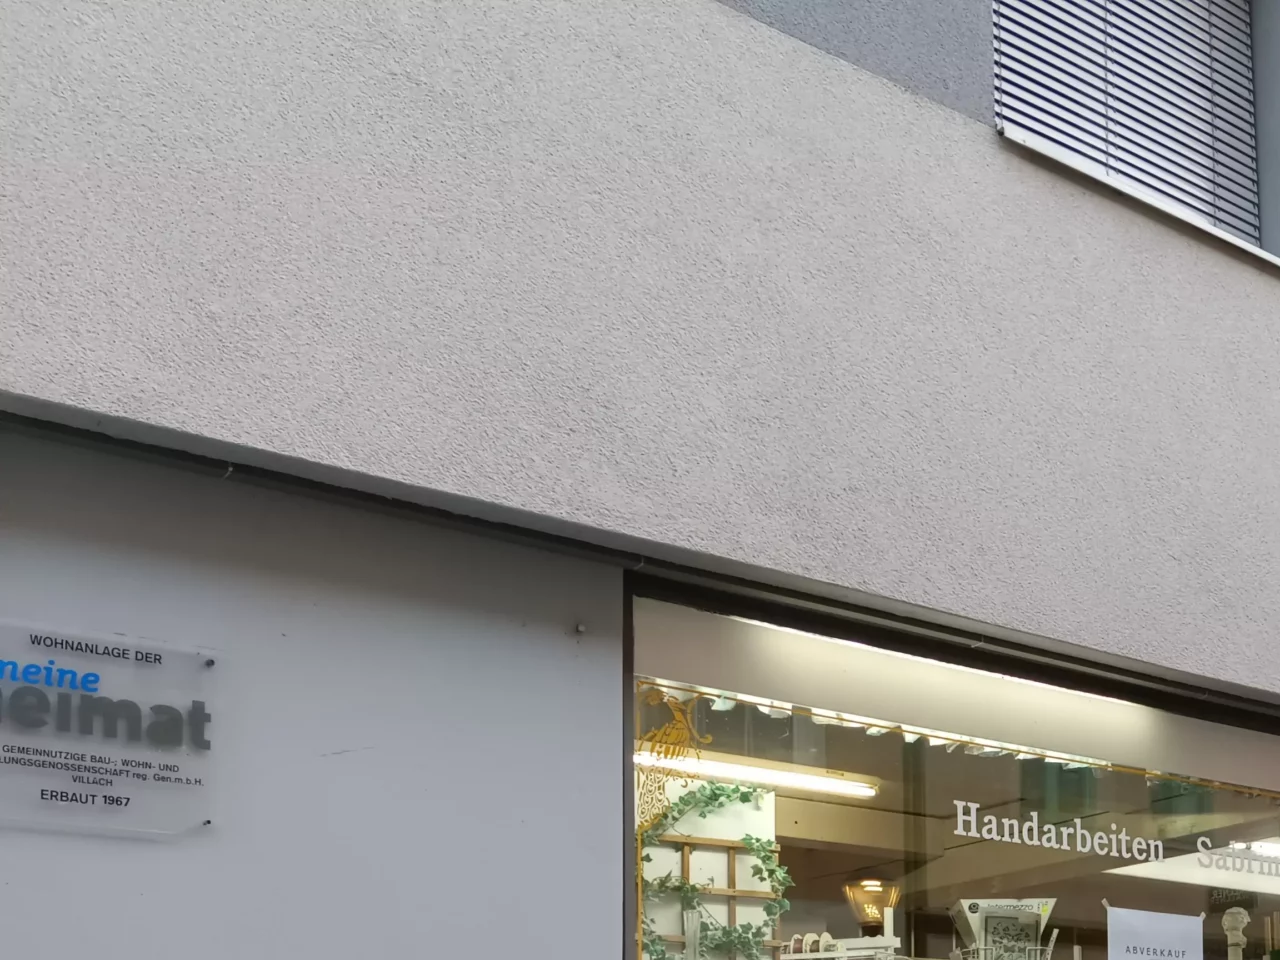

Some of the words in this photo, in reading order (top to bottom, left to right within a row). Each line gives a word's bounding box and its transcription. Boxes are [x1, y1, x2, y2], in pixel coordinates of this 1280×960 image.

[30, 633, 130, 660] WOHNANLAGE
[135, 650, 163, 665] DER
[0, 685, 211, 751] eimat
[121, 758, 156, 770] WOHN-
[158, 763, 180, 773] UND
[72, 775, 113, 787] VILLACH
[40, 788, 99, 805] ERBAUT
[102, 795, 131, 807] 1967
[953, 799, 1165, 863] Handarbeiten
[1125, 945, 1187, 959] ABVERKAUF
